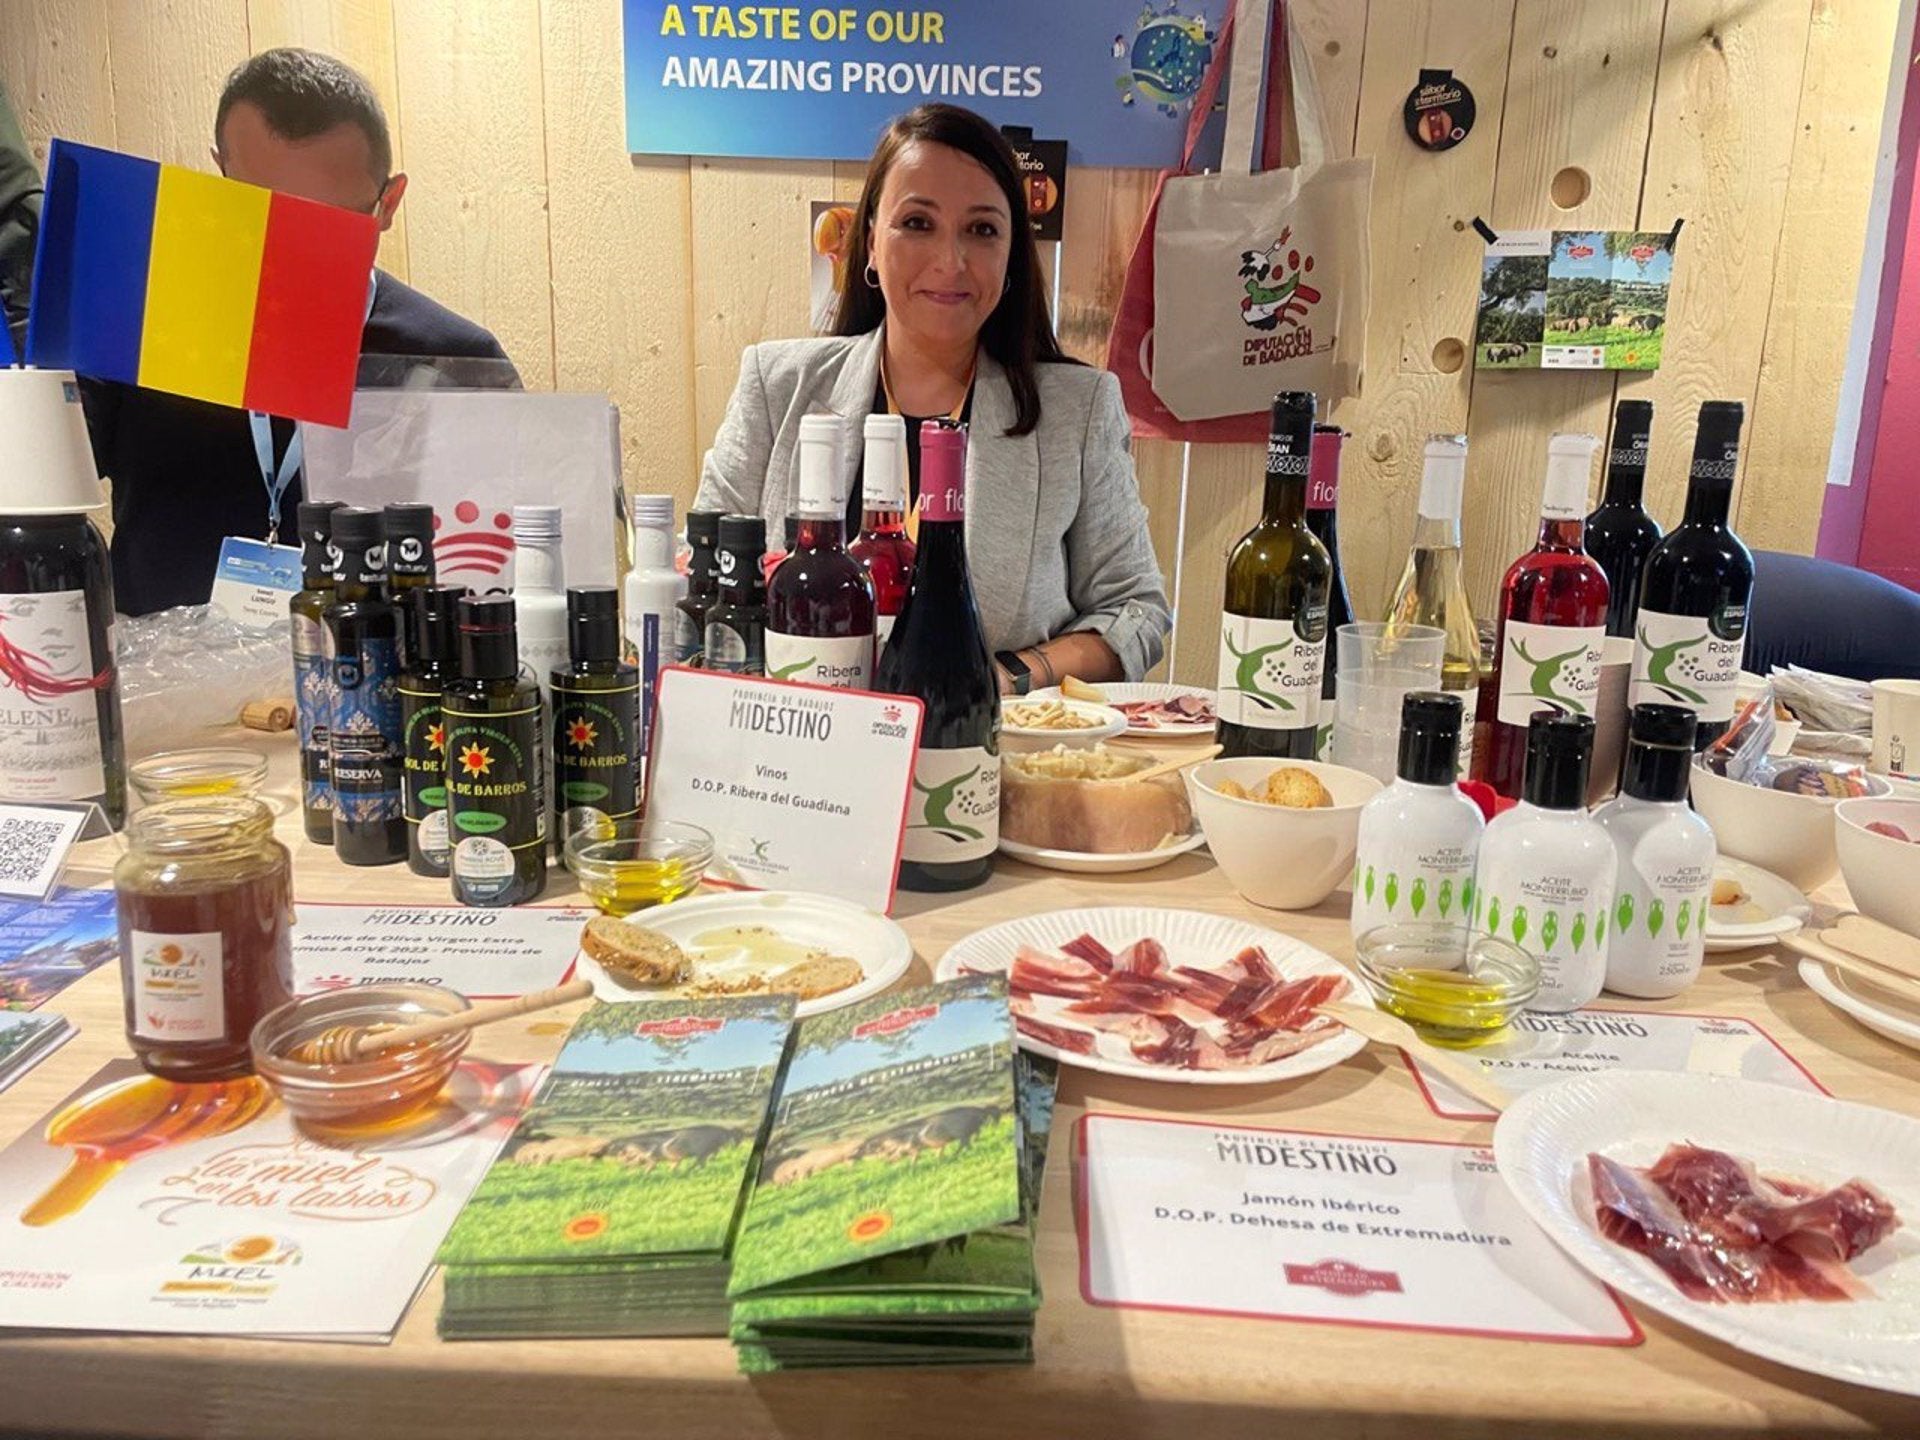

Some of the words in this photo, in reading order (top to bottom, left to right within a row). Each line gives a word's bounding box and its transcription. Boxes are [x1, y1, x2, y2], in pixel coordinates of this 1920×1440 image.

[660, 4, 686, 36] A
[692, 5, 800, 40] TASTE
[809, 8, 857, 41] OF
[866, 10, 945, 44] OUR
[661, 56, 833, 92] AMAZING
[842, 61, 1043, 98] PROVINCES
[1243, 356, 1256, 366] DE
[1259, 343, 1313, 365] BADAJOZ
[1718, 657, 1735, 668] del
[817, 665, 861, 677] Ribera
[733, 689, 776, 703] PROVINCIA
[782, 696, 792, 705] DE
[729, 701, 832, 741] MIDESTINO
[423, 760, 438, 772] DE
[580, 753, 628, 768] BARROS
[756, 765, 788, 781] Vinos
[457, 783, 471, 796] DE
[474, 781, 527, 797] BARROS
[692, 778, 726, 795] D.O.P.
[730, 784, 768, 802] Ribera
[771, 791, 790, 805] del
[792, 795, 851, 816] Guadiana
[1541, 876, 1572, 887] ACEITE
[362, 914, 497, 926] MIDESTINO
[302, 934, 352, 942] Aceite
[356, 934, 377, 942] de
[381, 935, 422, 943] Oliva
[428, 936, 478, 945] Virgen
[391, 946, 428, 954] 2023
[442, 947, 517, 955] Provincia
[364, 957, 431, 966] Badajoz
[1480, 1059, 1538, 1070] D.O.P.
[1562, 1051, 1621, 1062] Aceite
[804, 1081, 853, 1102] DEHESA
[860, 1074, 874, 1086] DE
[882, 1050, 976, 1081] EXTREMADURA
[1216, 1142, 1397, 1176] MIDESTINO
[248, 1156, 382, 1184] miel
[217, 1183, 281, 1208] los
[287, 1184, 411, 1209] labios
[1242, 1191, 1315, 1209] Jamón
[1321, 1197, 1401, 1216] Ibérico
[1154, 1207, 1223, 1224] D.O.P.
[1230, 1212, 1315, 1231] Dehesa
[1322, 1220, 1350, 1233] de
[1356, 1222, 1513, 1246] Extremadura
